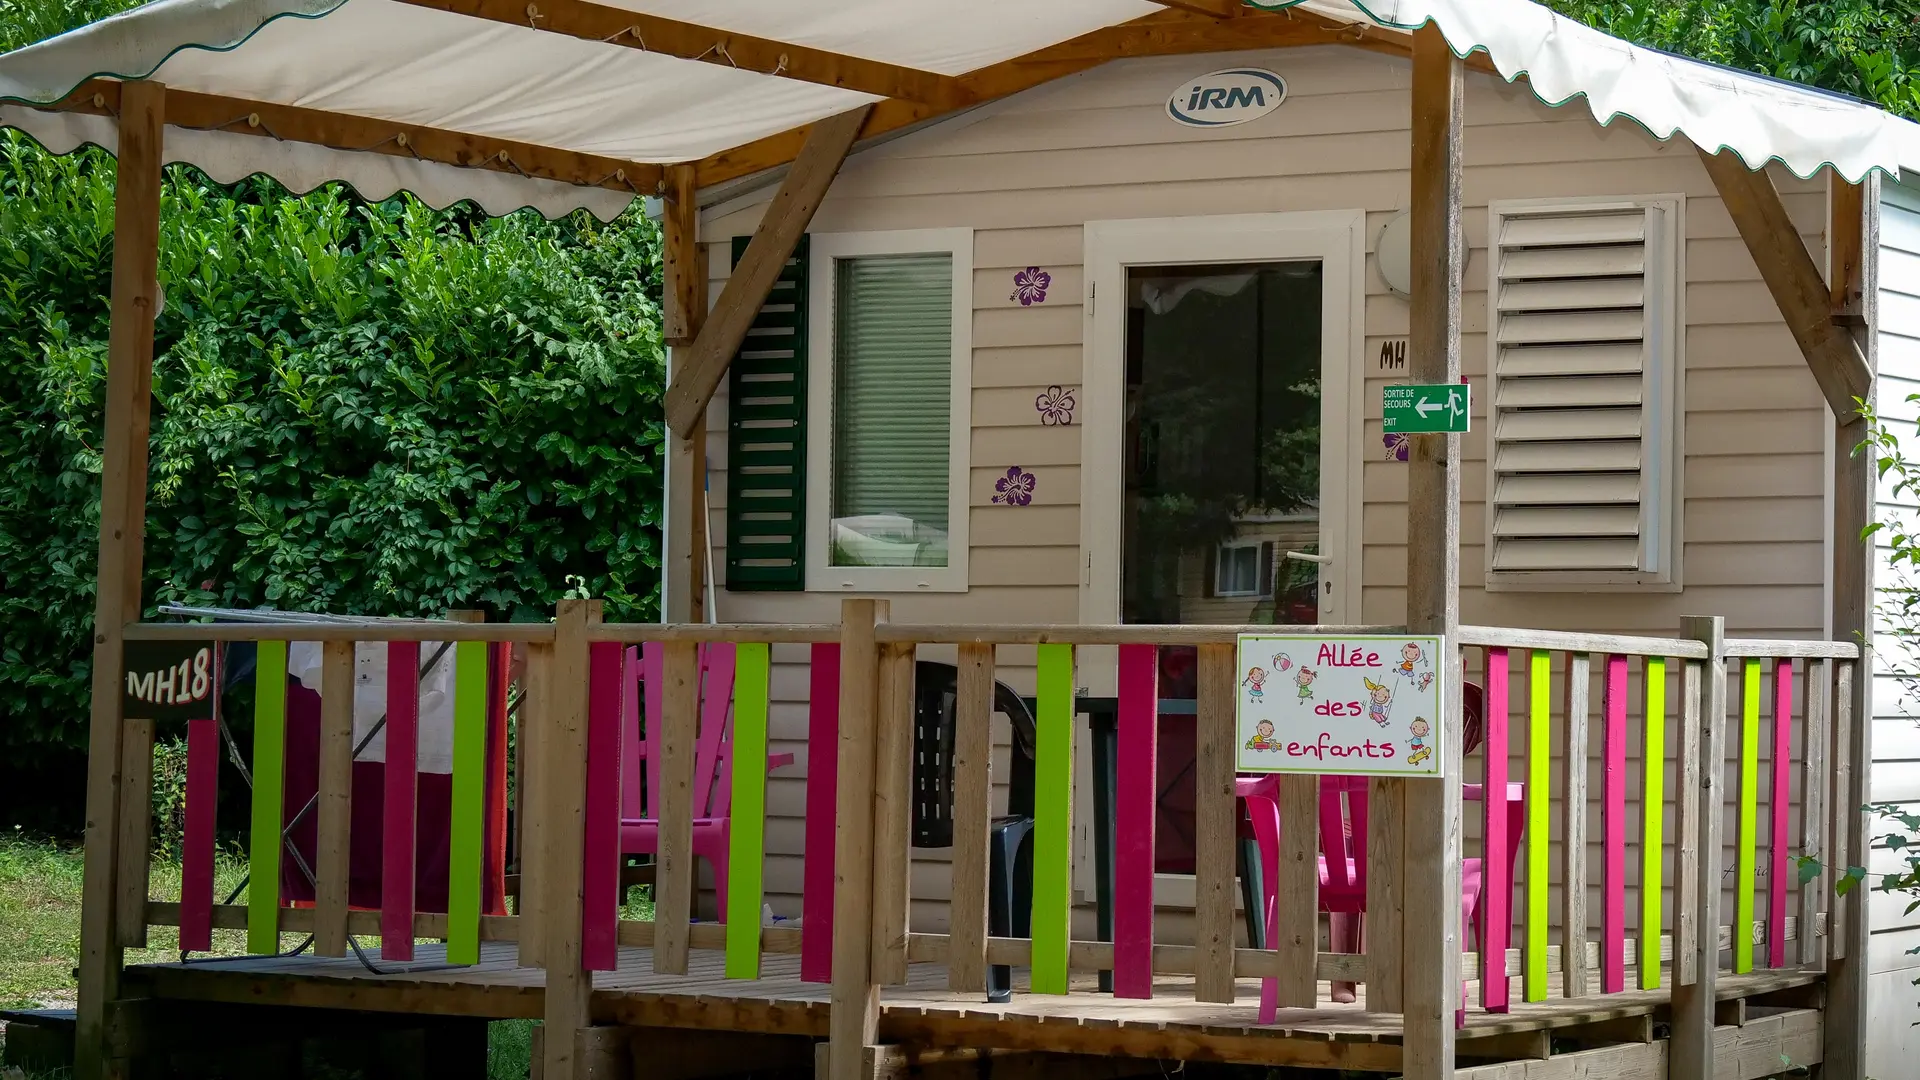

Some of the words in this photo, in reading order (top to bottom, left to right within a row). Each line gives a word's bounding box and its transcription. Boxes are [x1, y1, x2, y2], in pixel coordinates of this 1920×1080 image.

[1380, 340, 1406, 370] MH
[1383, 389, 1405, 398] SORTIE
[1405, 389, 1414, 398] DE
[1383, 399, 1411, 409] SECOURS
[1383, 417, 1397, 426] EXIT
[1316, 643, 1383, 667] Allée
[128, 647, 211, 705] MH18
[1314, 699, 1362, 717] des
[1286, 732, 1395, 761] enfants
